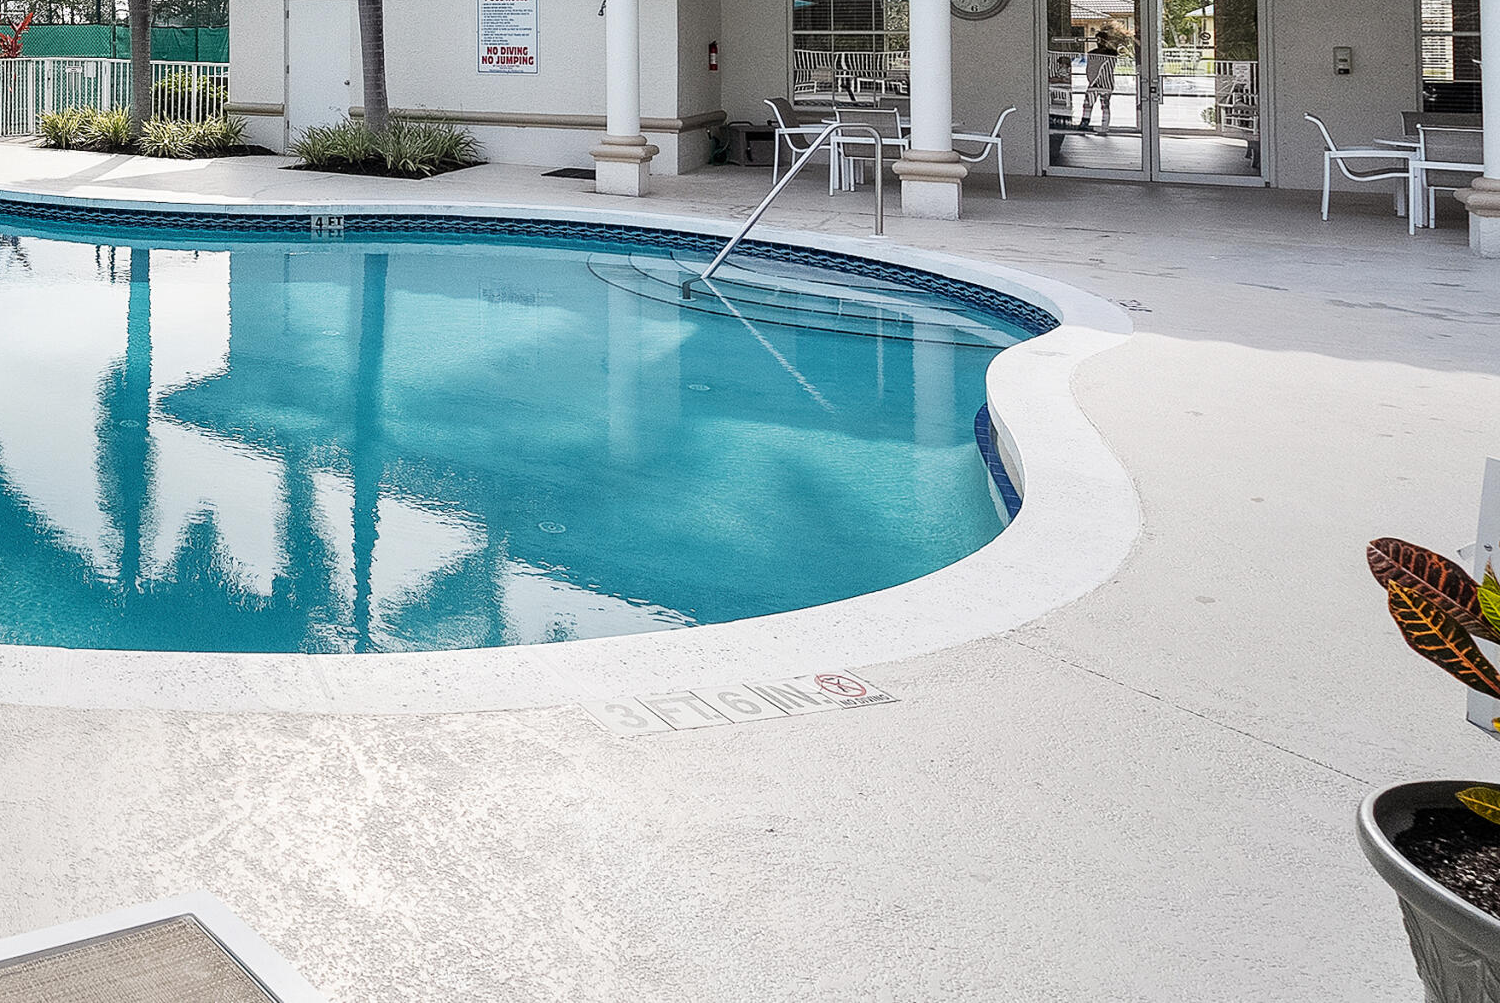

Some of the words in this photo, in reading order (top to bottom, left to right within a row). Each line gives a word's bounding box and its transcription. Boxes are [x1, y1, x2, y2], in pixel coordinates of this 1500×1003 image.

[486, 46, 498, 55] NO
[500, 46, 528, 56] DIVING
[481, 55, 494, 64] NO
[495, 55, 534, 65] JUMPING
[315, 217, 323, 228] 4
[328, 216, 342, 226] FT
[855, 694, 890, 704] DIVING
[604, 703, 649, 729] 3
[717, 691, 762, 714] 6
